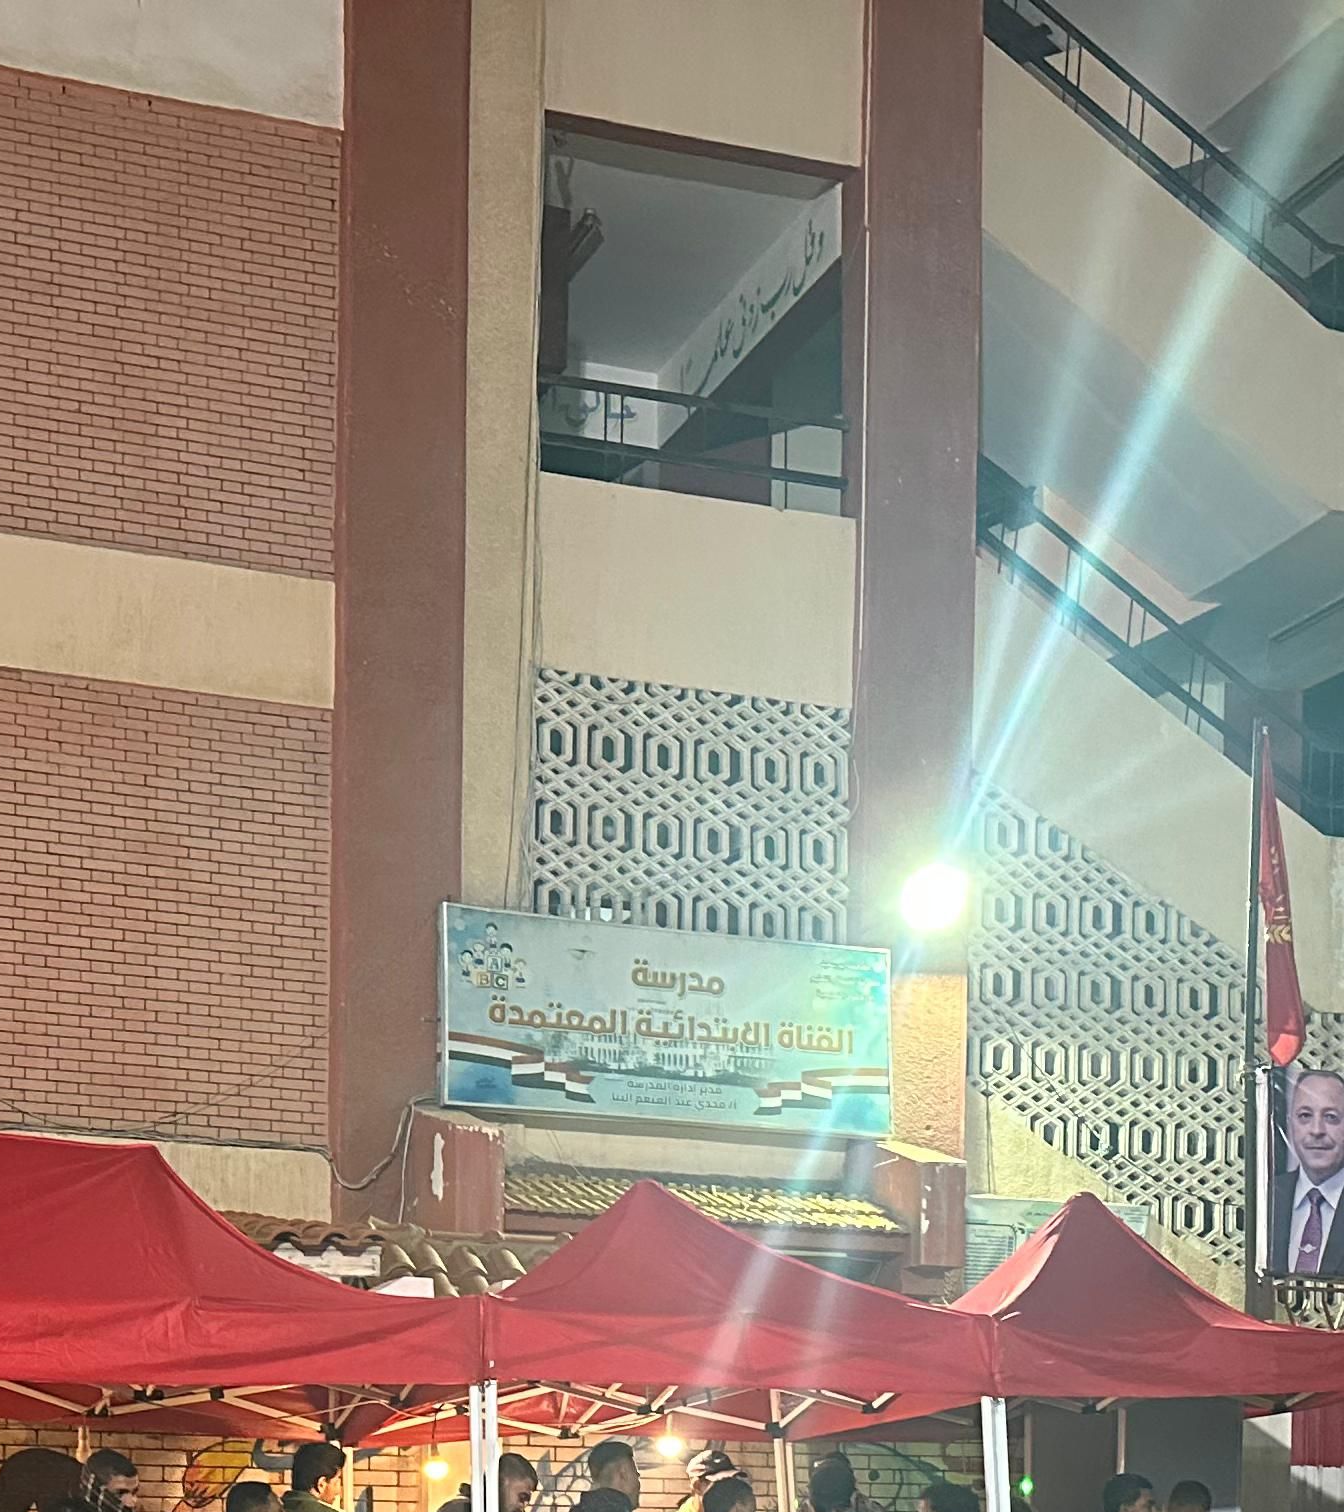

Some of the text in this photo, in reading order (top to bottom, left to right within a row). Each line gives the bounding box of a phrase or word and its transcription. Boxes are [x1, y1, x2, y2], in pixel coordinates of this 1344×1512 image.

[630, 957, 726, 998] مدرسة
[488, 993, 854, 1054] القناة الابتدائية المعتمدة
